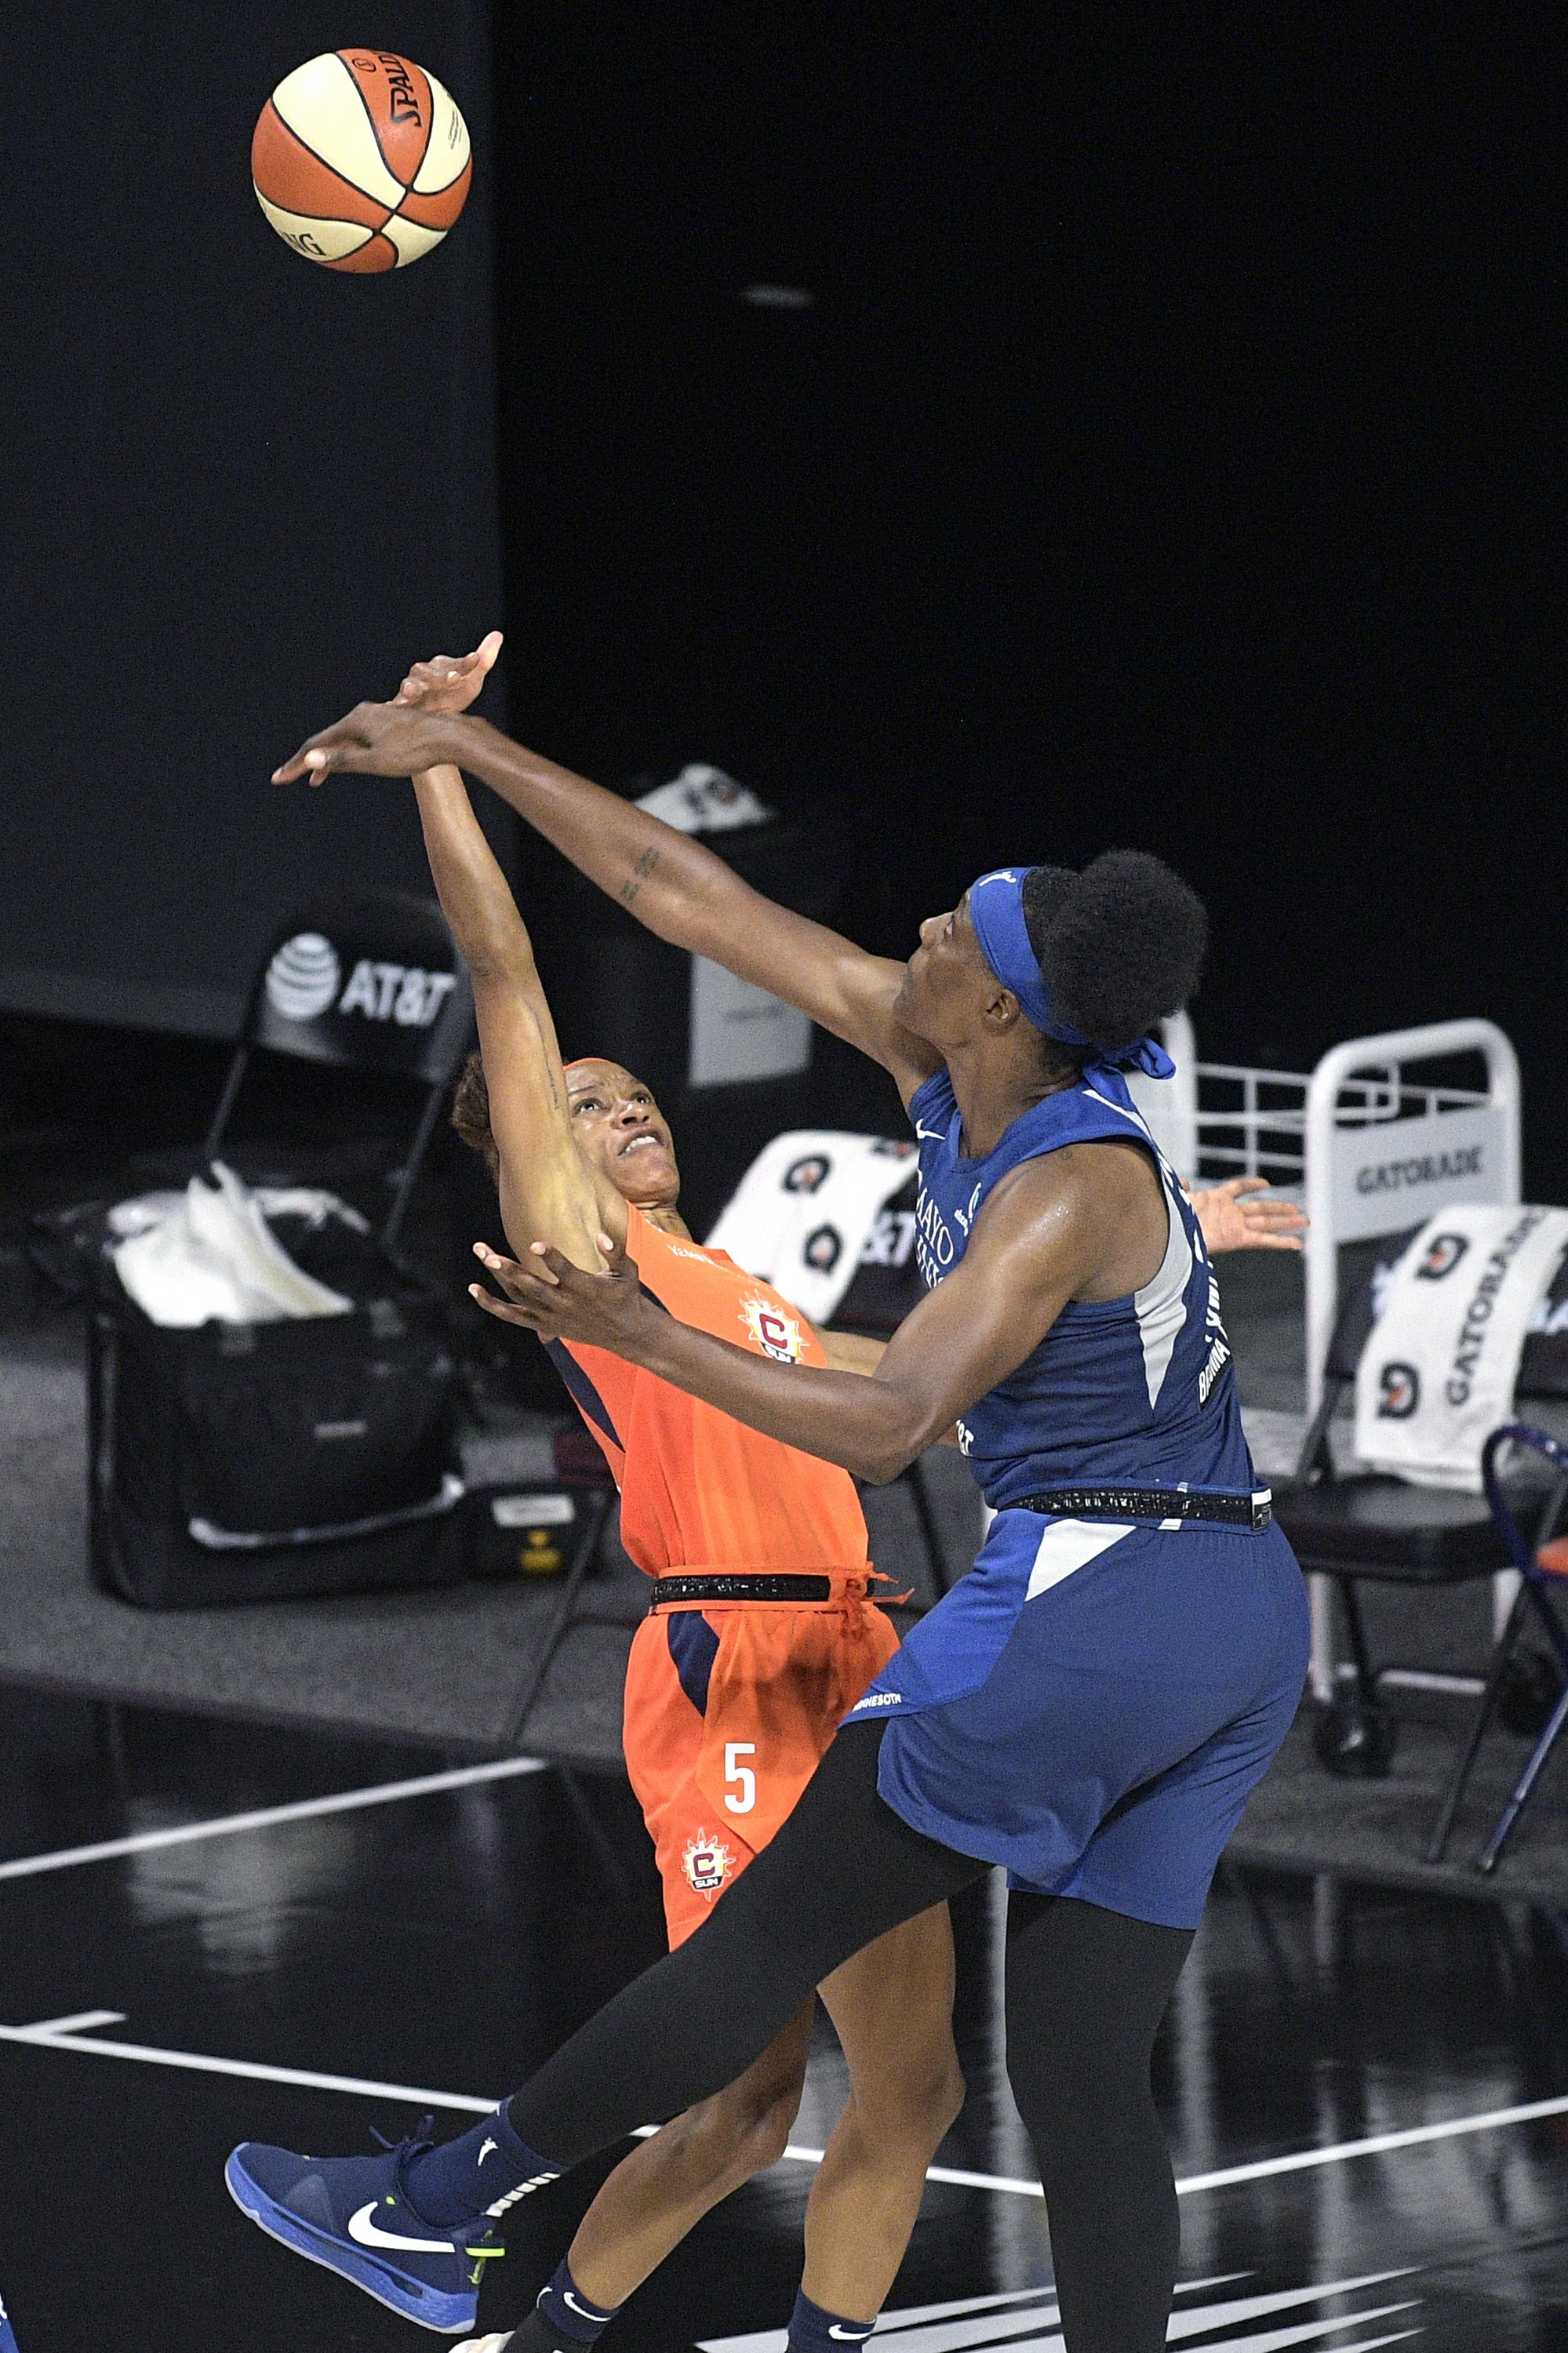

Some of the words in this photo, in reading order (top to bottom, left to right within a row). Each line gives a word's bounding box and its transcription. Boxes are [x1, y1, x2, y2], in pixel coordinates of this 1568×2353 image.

[377, 53, 421, 127] SPALD
[339, 958, 457, 1027] AT&T
[759, 1313, 788, 1350] C
[1446, 1211, 1545, 1406] GATORA
[852, 1693, 902, 1713] NNESOTA
[724, 1742, 755, 1814] 5
[693, 1852, 715, 1878] C
[694, 1878, 719, 1888] SUN
